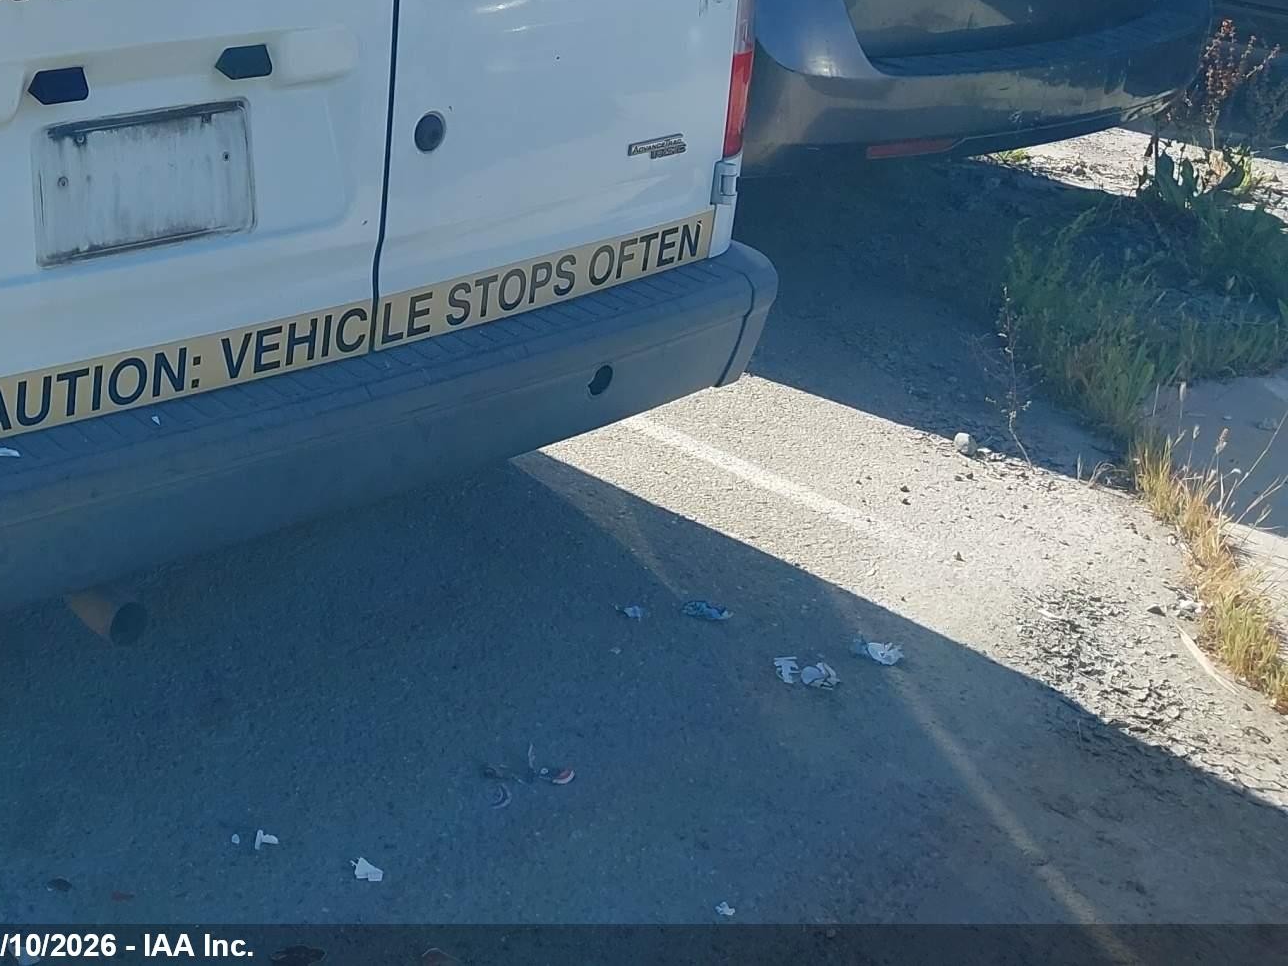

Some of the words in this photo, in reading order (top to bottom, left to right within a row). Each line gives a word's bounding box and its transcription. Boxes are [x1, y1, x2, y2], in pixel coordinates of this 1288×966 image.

[220, 291, 433, 379] VEHICLE
[445, 254, 577, 326] STOPS
[588, 220, 703, 286] OFTEN
